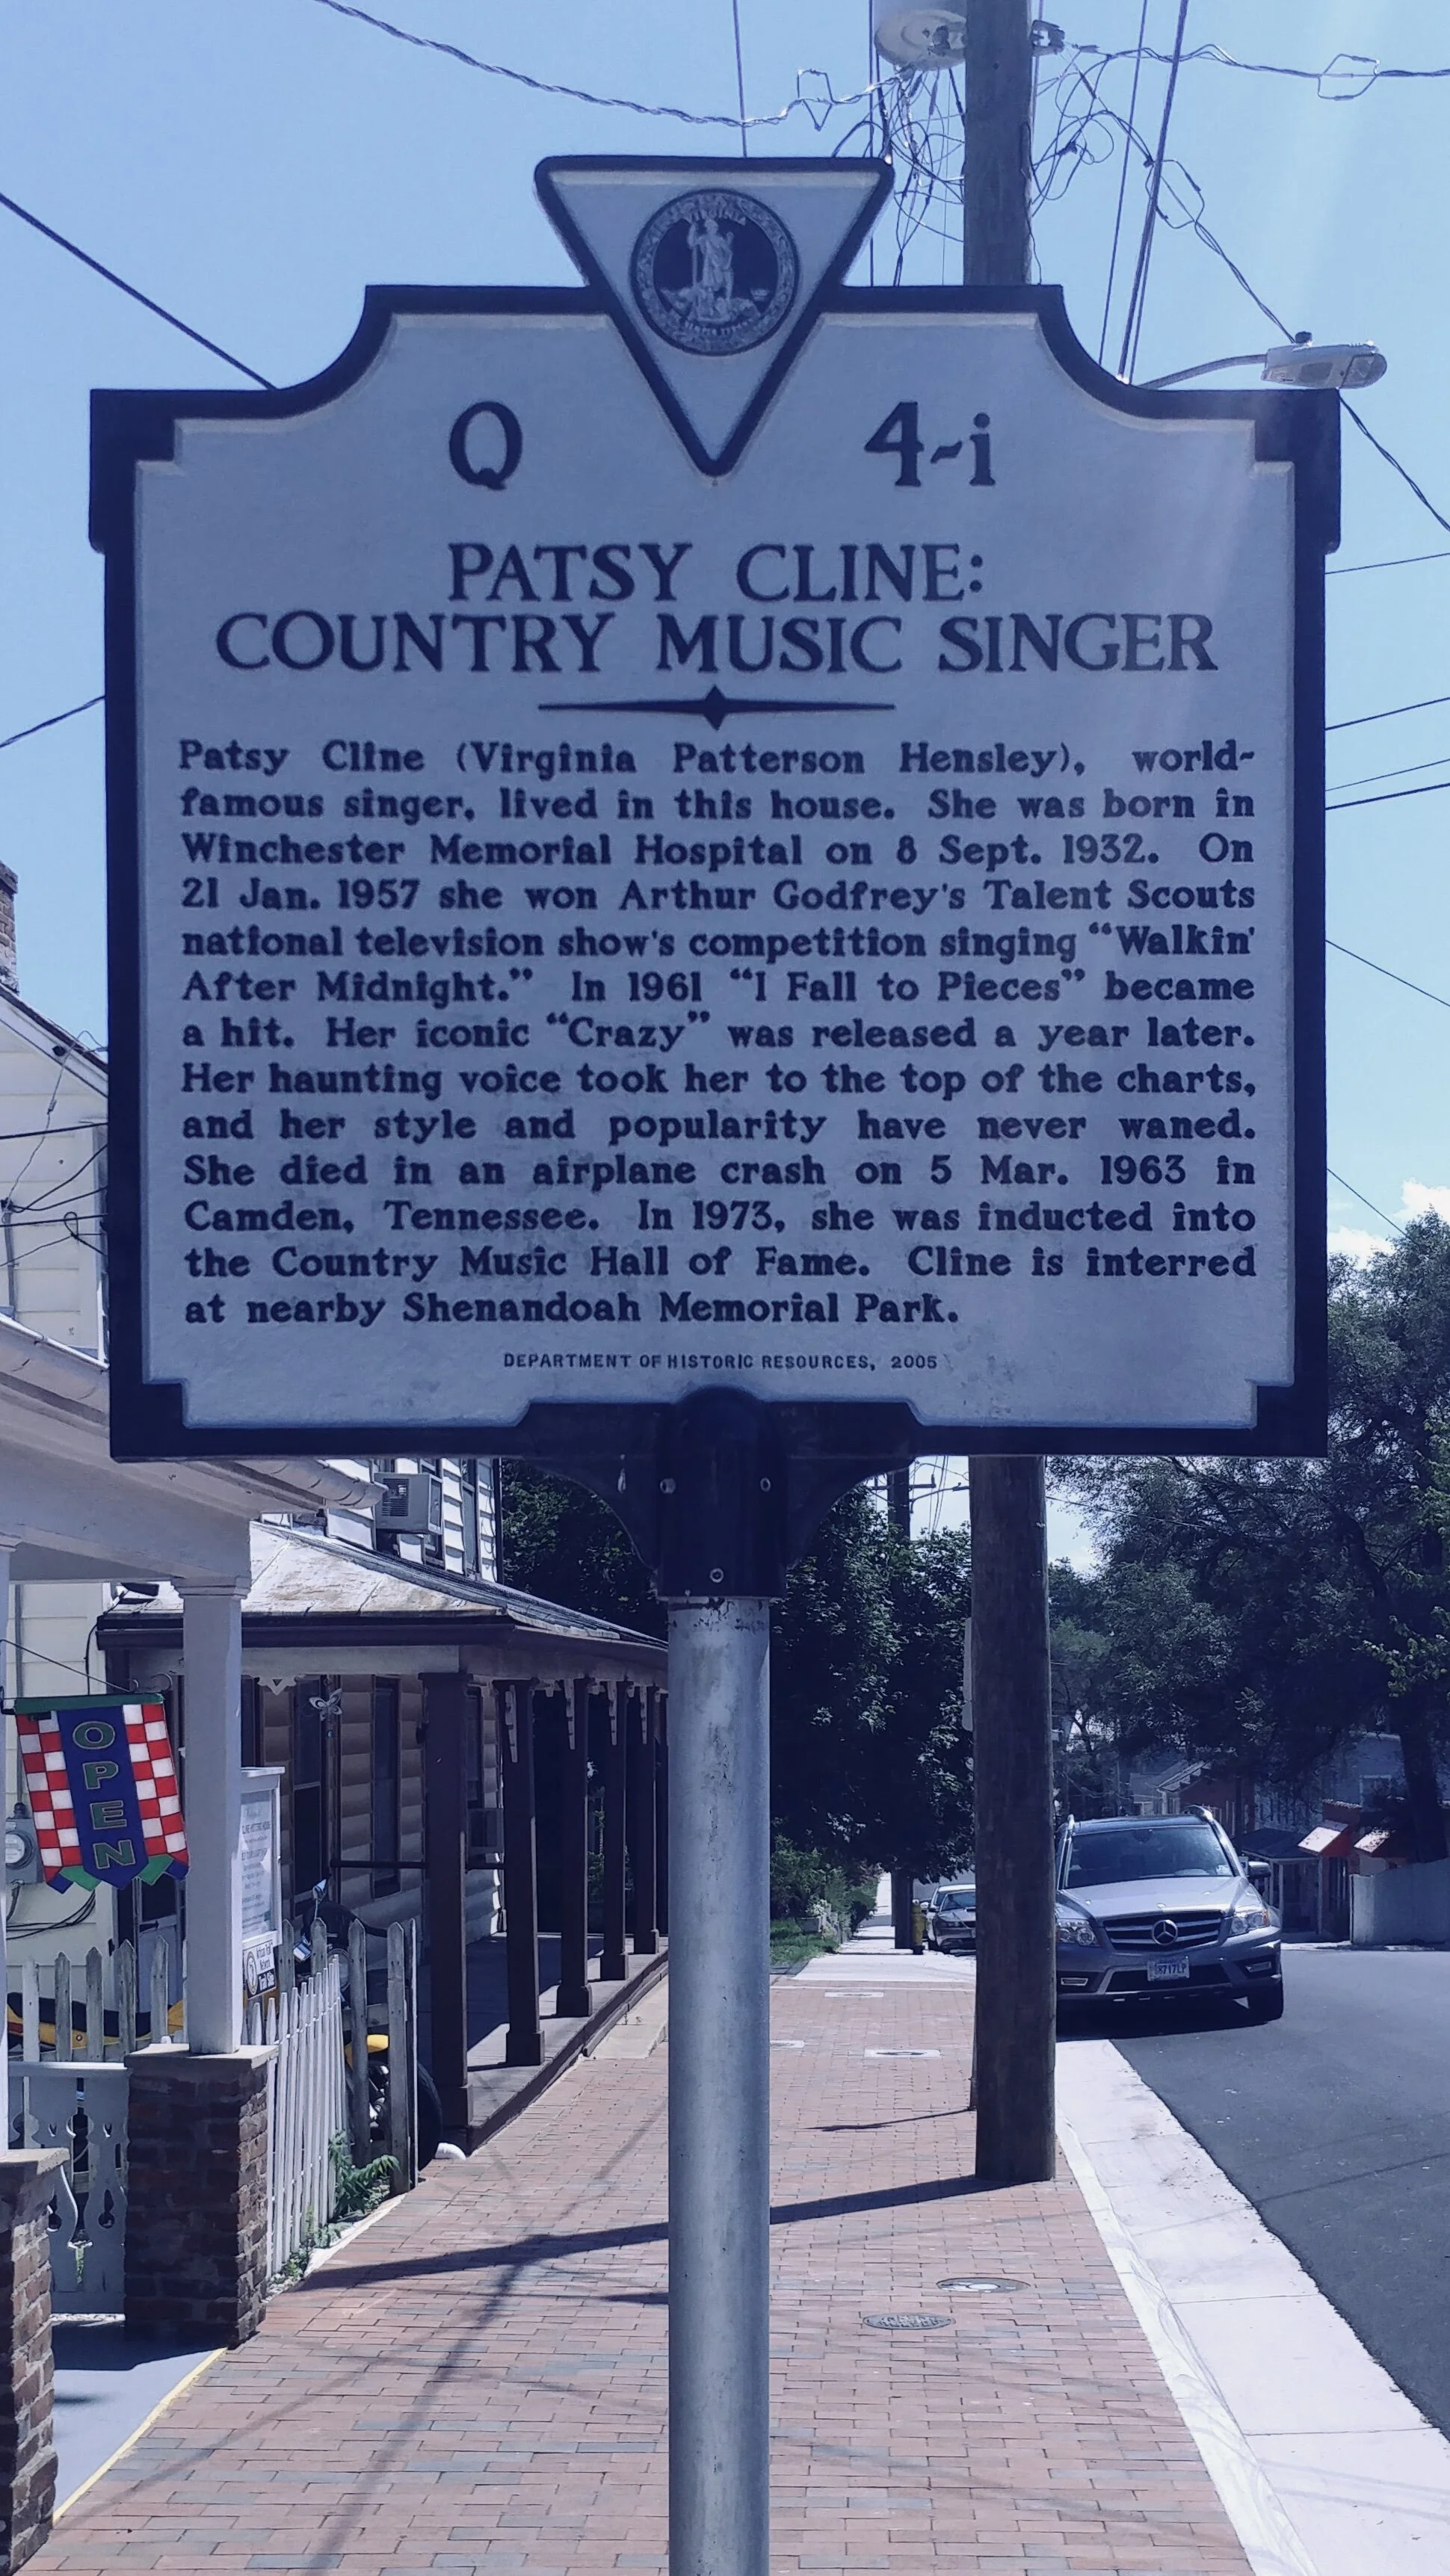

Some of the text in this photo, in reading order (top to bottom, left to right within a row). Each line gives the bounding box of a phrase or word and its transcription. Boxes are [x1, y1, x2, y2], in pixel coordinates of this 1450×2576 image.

[448, 400, 996, 492] Q 4-i
[448, 542, 984, 604] PATSY CLINE:
[215, 609, 1219, 674] COUNTRY MUSIC SINGER
[179, 738, 1256, 782] Patsy Cline (Virginia Patterson Hensley), world-
[179, 785, 1255, 827] famous singer, lived in this house. She was born in
[179, 831, 1254, 874] Winchester Memorial Hospital on 8 Sept. 1932. On
[181, 876, 220, 909] 21
[238, 876, 321, 912] Jan.
[336, 877, 421, 910] 1957
[438, 878, 503, 910] she
[523, 886, 599, 910] won
[618, 878, 757, 911] Arthur
[982, 878, 1113, 911] Talent
[1126, 878, 1256, 910] Scouts
[181, 923, 345, 957] national
[354, 925, 545, 958] television
[688, 926, 928, 966] competition
[939, 925, 1077, 966] singing
[180, 969, 297, 1002] After
[571, 969, 607, 1003] In
[626, 970, 703, 1003] 1961
[786, 969, 858, 1003] Fall
[876, 971, 920, 1002] to
[1103, 969, 1255, 1002] became
[182, 1024, 206, 1048] a
[220, 1016, 294, 1050] hit.
[325, 1016, 397, 1050] Her
[415, 1016, 531, 1048] iconic
[726, 1024, 795, 1048] was
[811, 1016, 978, 1049] released
[994, 1025, 1017, 1048] a
[1037, 1024, 1130, 1053] year
[1146, 1016, 1256, 1048] later.
[180, 1061, 1256, 1102] Her haunting voice took her to the top of the charts,
[182, 1107, 1256, 1148] and her style and popularity have never waned.
[183, 1153, 1256, 1192] She died in an airplane crash on 5 Mar. 1963 in
[183, 1198, 1256, 1236] Camden, Tennessee. In 1973, she was inducted into
[183, 1244, 1257, 1283] the Country Music Hall of Fame. Cline is interred
[185, 1290, 959, 1328] at nearby Shenandoah Memorial Park.
[503, 1351, 938, 1372] DEPARTMENT OF HISTORIC RESOURCES, 2005
[72, 1720, 137, 1870] OPEN
